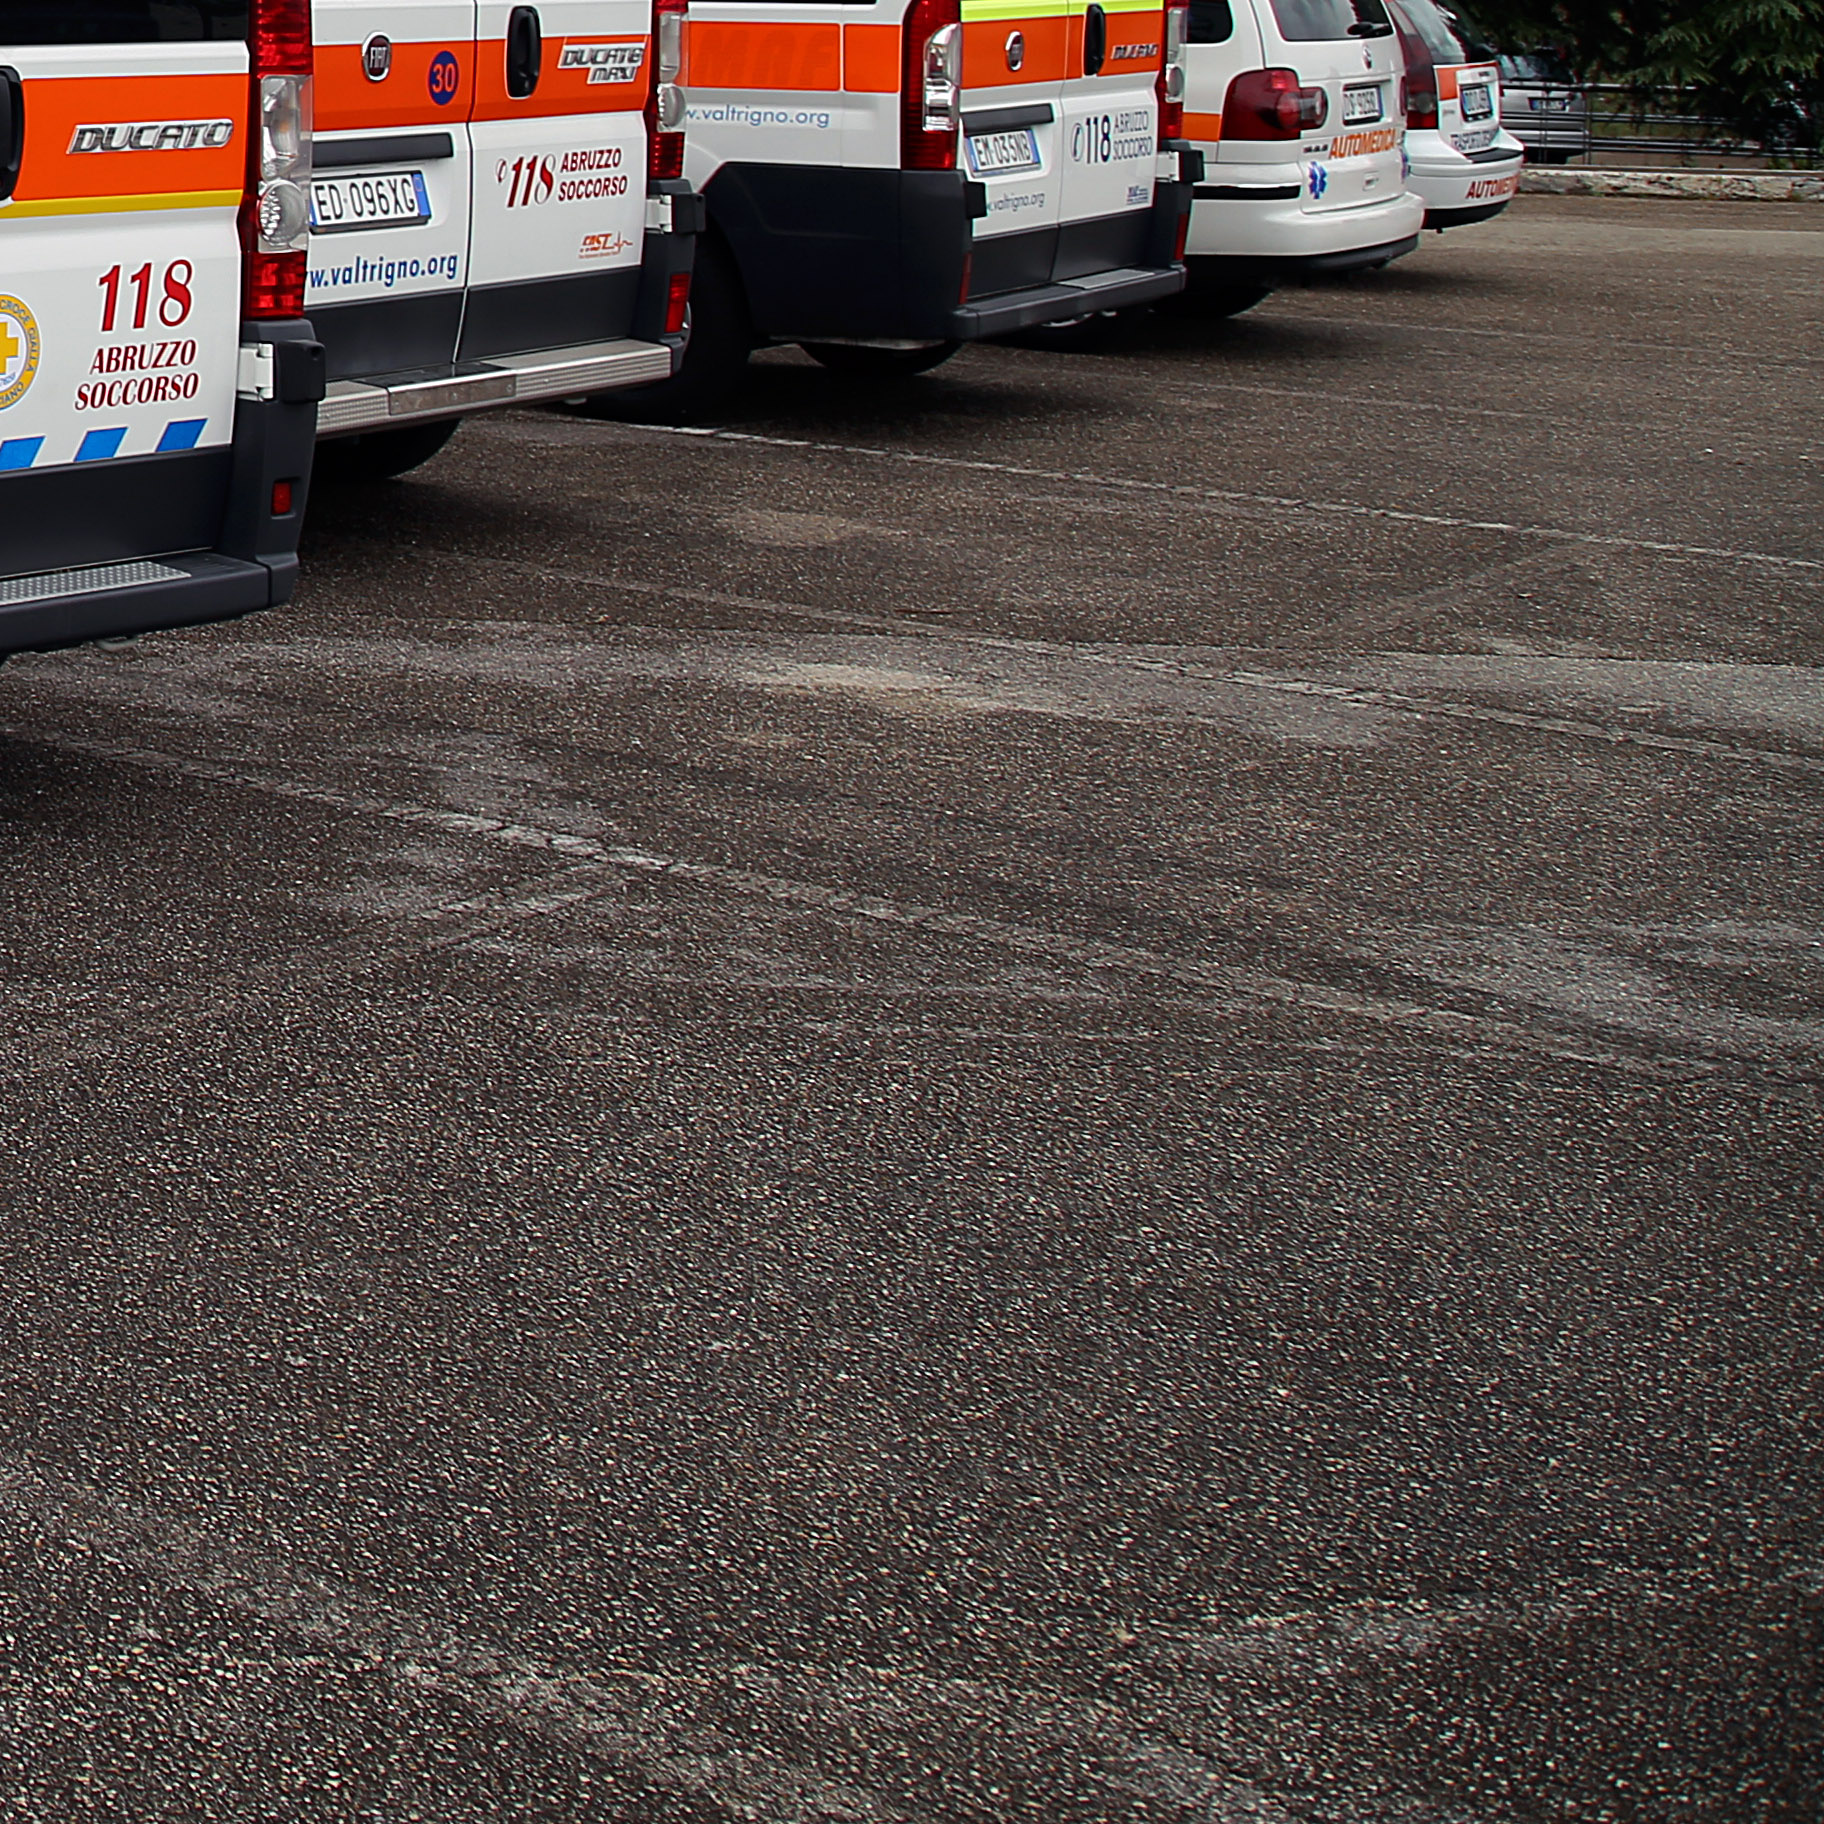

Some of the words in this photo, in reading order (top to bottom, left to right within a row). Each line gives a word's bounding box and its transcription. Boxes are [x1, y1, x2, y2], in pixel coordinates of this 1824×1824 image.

[431, 63, 456, 94] 30
[70, 119, 234, 154] DUCATO
[1086, 114, 1111, 165] 118
[506, 153, 556, 208] 118
[560, 147, 622, 173] ABRUZZO
[558, 175, 628, 202] SOCCORSO
[314, 184, 344, 221] ED
[350, 178, 416, 218] 096XG
[306, 254, 458, 288] w.valtrigno.org
[97, 259, 195, 332] 118
[87, 339, 197, 375] ABRUZZO
[74, 372, 200, 412] SOCCORSO
